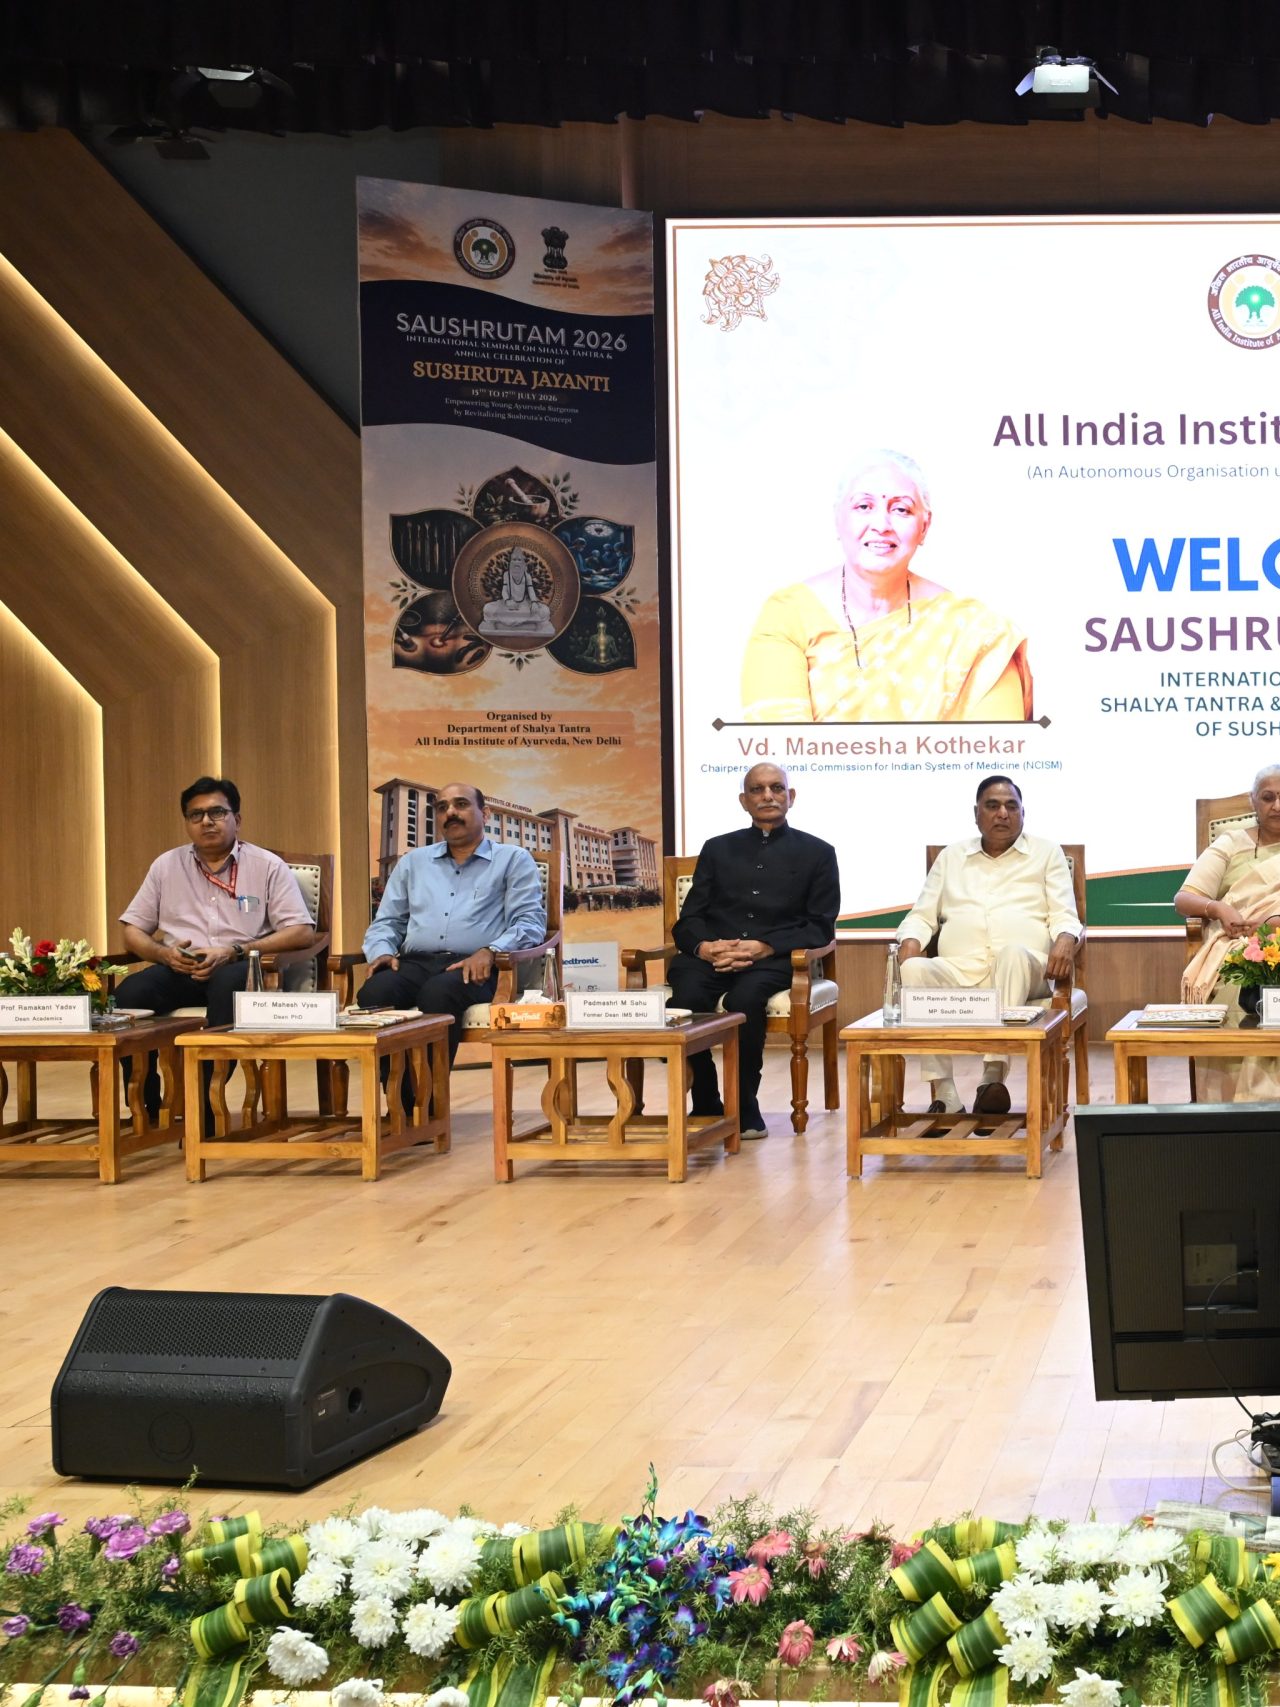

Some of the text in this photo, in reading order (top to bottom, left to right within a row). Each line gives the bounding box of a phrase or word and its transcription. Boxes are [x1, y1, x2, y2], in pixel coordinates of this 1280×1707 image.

[396, 313, 628, 352] SAUSHRUTAM 2026
[1212, 308, 1222, 324] All
[1217, 322, 1233, 339] India
[1232, 334, 1265, 347] Institute
[1266, 335, 1274, 345] of
[406, 335, 479, 348] INTERNATIONAL
[481, 341, 520, 351] SEMINAR
[522, 344, 536, 352] ON
[538, 345, 569, 356] SHALYA
[572, 349, 604, 359] TANTRA
[454, 350, 490, 360] ANNUAL
[493, 352, 550, 364] CELEBRATION
[413, 360, 610, 392] SUSHRUTA JAYANTI
[993, 413, 1048, 446] All
[1062, 412, 1165, 446] India
[1027, 465, 1053, 479] (An
[1058, 465, 1162, 479] Autonomous
[1167, 464, 1269, 481] Organisation
[1101, 697, 1179, 713] SHALYA
[1184, 696, 1264, 712] TANTRA
[487, 711, 552, 722] Organised by
[447, 724, 591, 734] Department of Shalya Tantra
[1196, 722, 1222, 737] OF
[415, 736, 621, 747] All India Institute of Ayurveda, New Delhi
[738, 736, 1025, 756] Vd. Maneesha Kothekar
[701, 764, 750, 774] Chairpers
[810, 763, 874, 772] Commission
[875, 762, 888, 770] for
[892, 762, 922, 771] Indian
[924, 762, 960, 772] System
[964, 762, 973, 770] of
[976, 761, 1020, 770] Medicine
[1023, 761, 1062, 771] (NCISM)
[562, 957, 599, 965] edtronic
